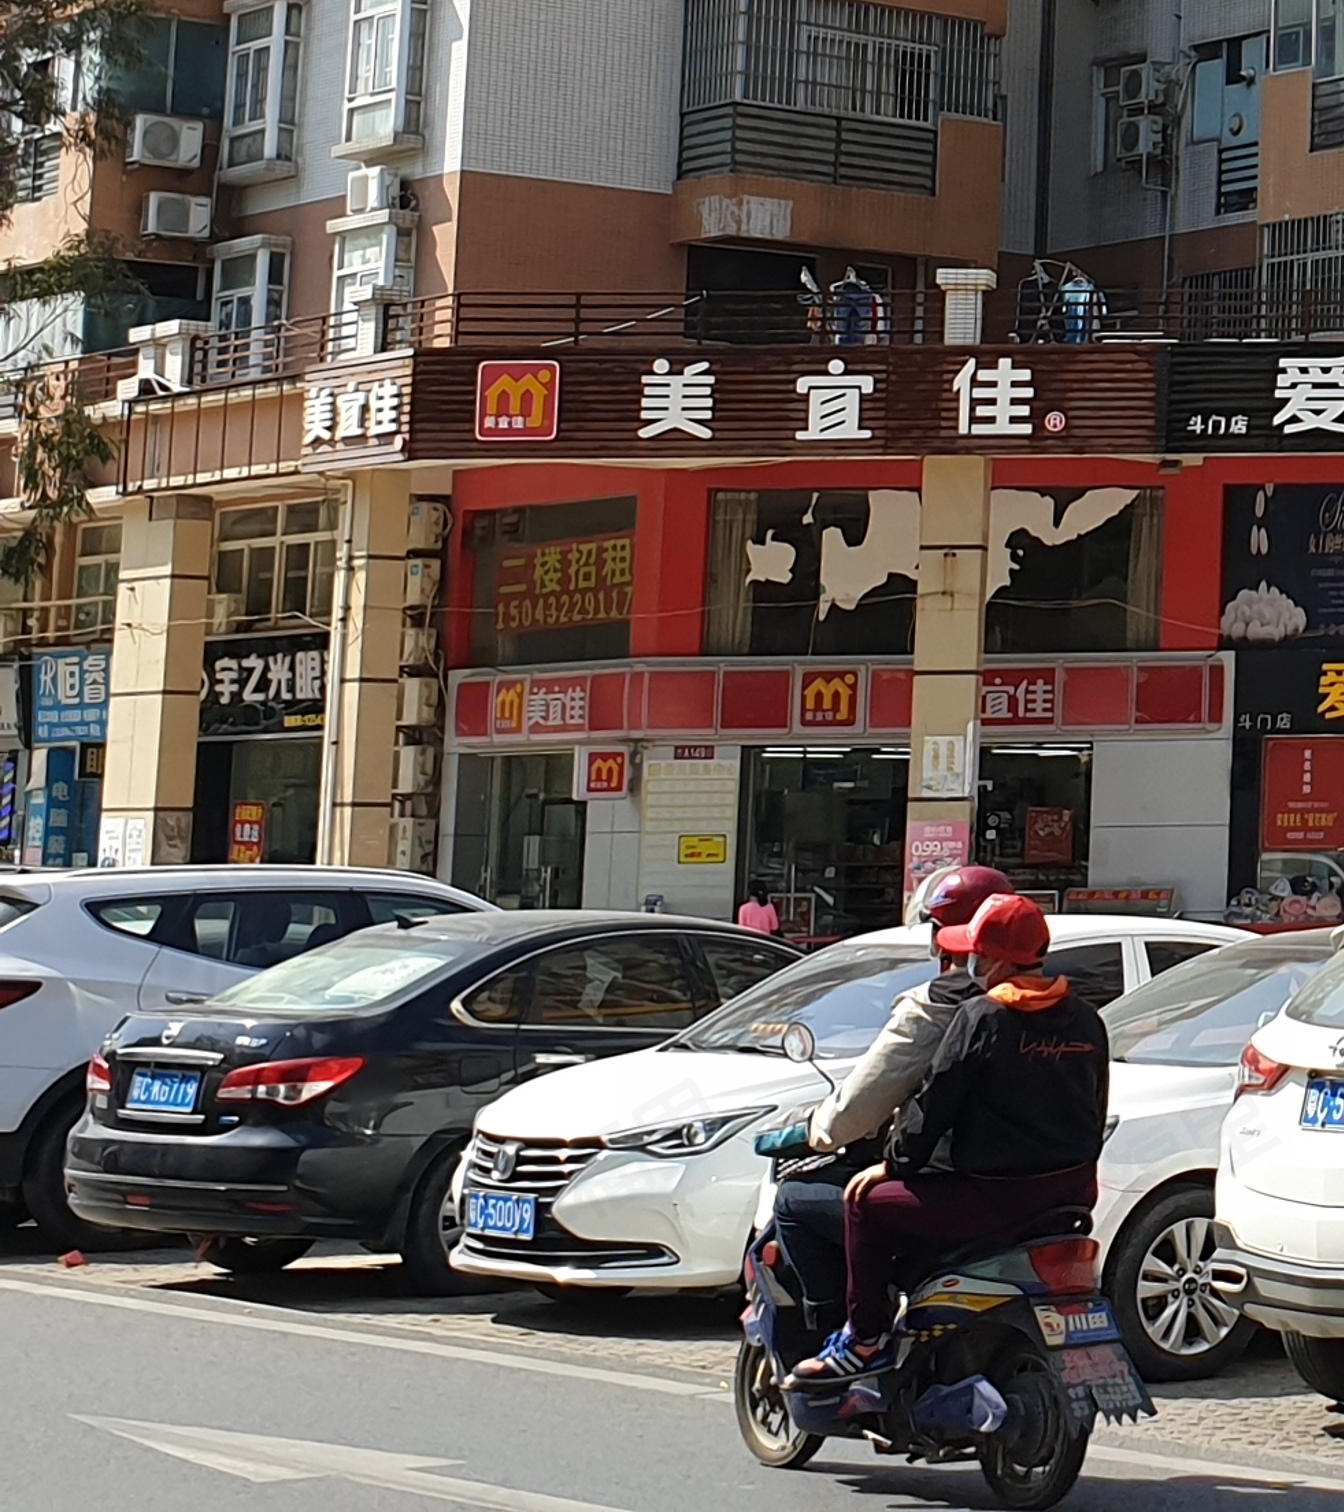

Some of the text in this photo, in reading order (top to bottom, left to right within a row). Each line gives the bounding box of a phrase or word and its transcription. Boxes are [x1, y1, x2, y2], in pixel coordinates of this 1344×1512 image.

[302, 379, 400, 445] 美宜佳
[638, 357, 1035, 440] 美宜佳
[1186, 414, 1249, 436] 斗门店
[499, 538, 632, 595] 二楼招租
[496, 587, 633, 630] 15043229117
[214, 650, 329, 704] 宇之光眼
[527, 686, 586, 727] 美宜佳
[1237, 712, 1292, 730] 斗门店
